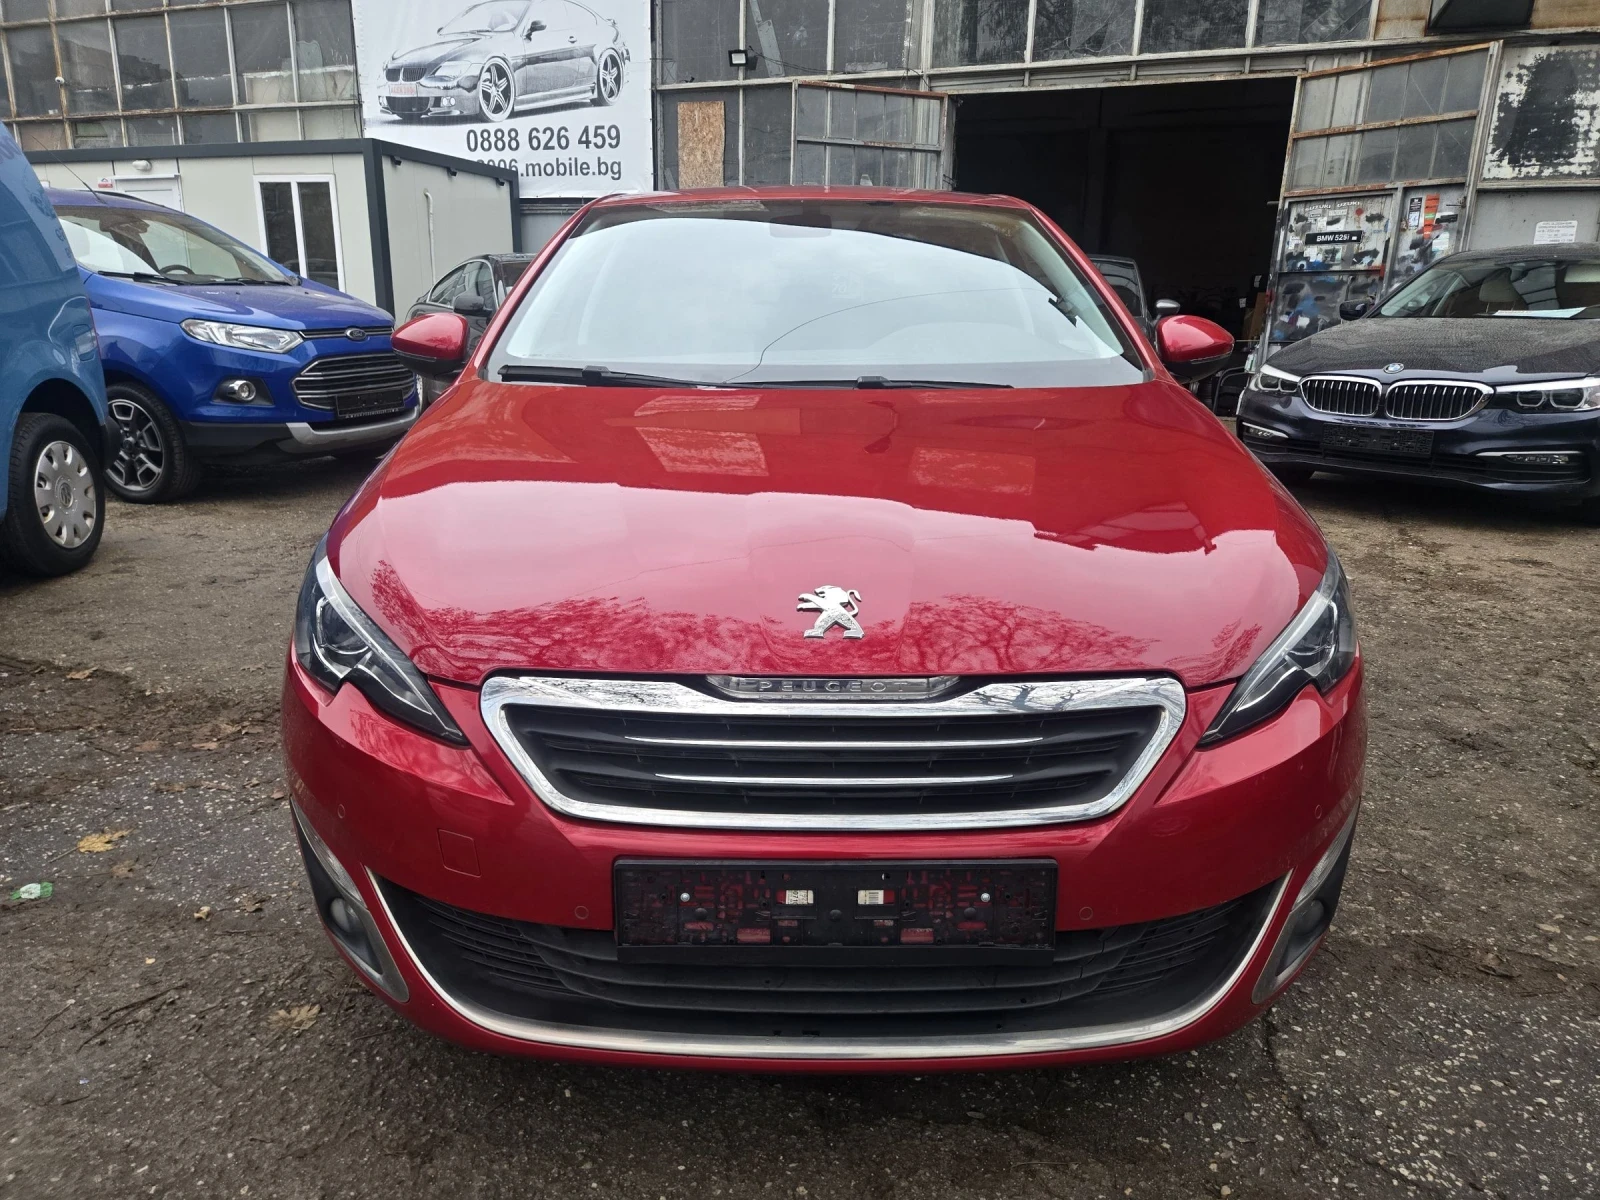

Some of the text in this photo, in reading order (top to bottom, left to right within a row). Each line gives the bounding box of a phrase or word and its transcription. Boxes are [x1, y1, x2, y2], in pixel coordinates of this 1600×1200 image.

[466, 124, 621, 152] 0888 626 459
[1316, 234, 1335, 242] BMW
[759, 681, 909, 693] PEUGEOT
